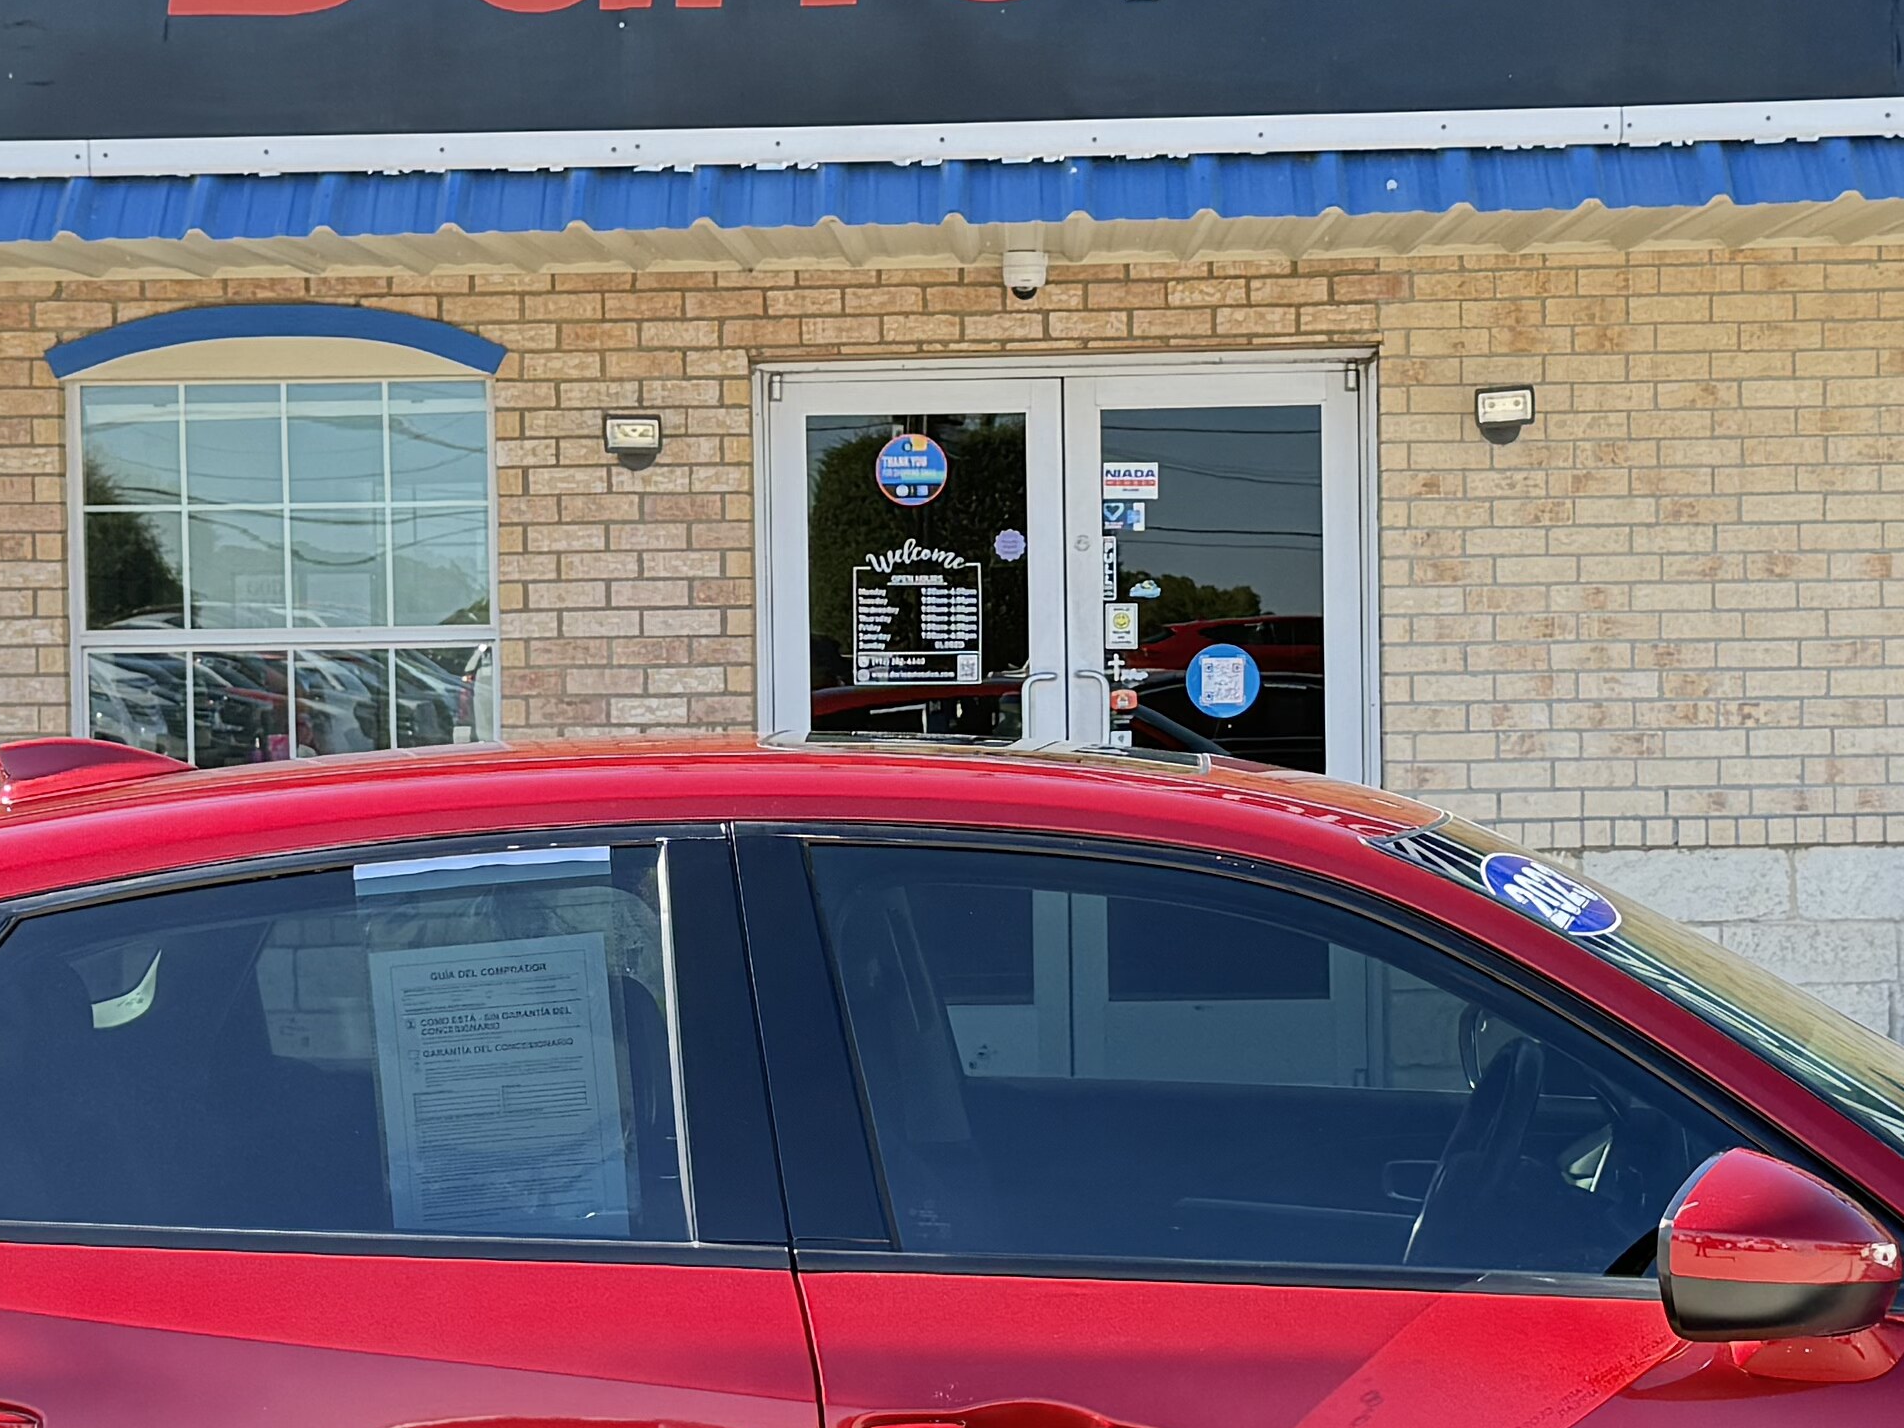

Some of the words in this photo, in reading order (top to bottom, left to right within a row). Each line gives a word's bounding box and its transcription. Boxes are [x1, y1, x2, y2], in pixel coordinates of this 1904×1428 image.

[1105, 469, 1156, 478] NIADA
[865, 538, 965, 573] Welcome
[1503, 861, 1599, 931] 2023
[430, 968, 454, 980] GUÍA
[458, 969, 478, 979] DEL
[552, 1006, 572, 1016] DEL
[474, 1043, 493, 1053] DEL
